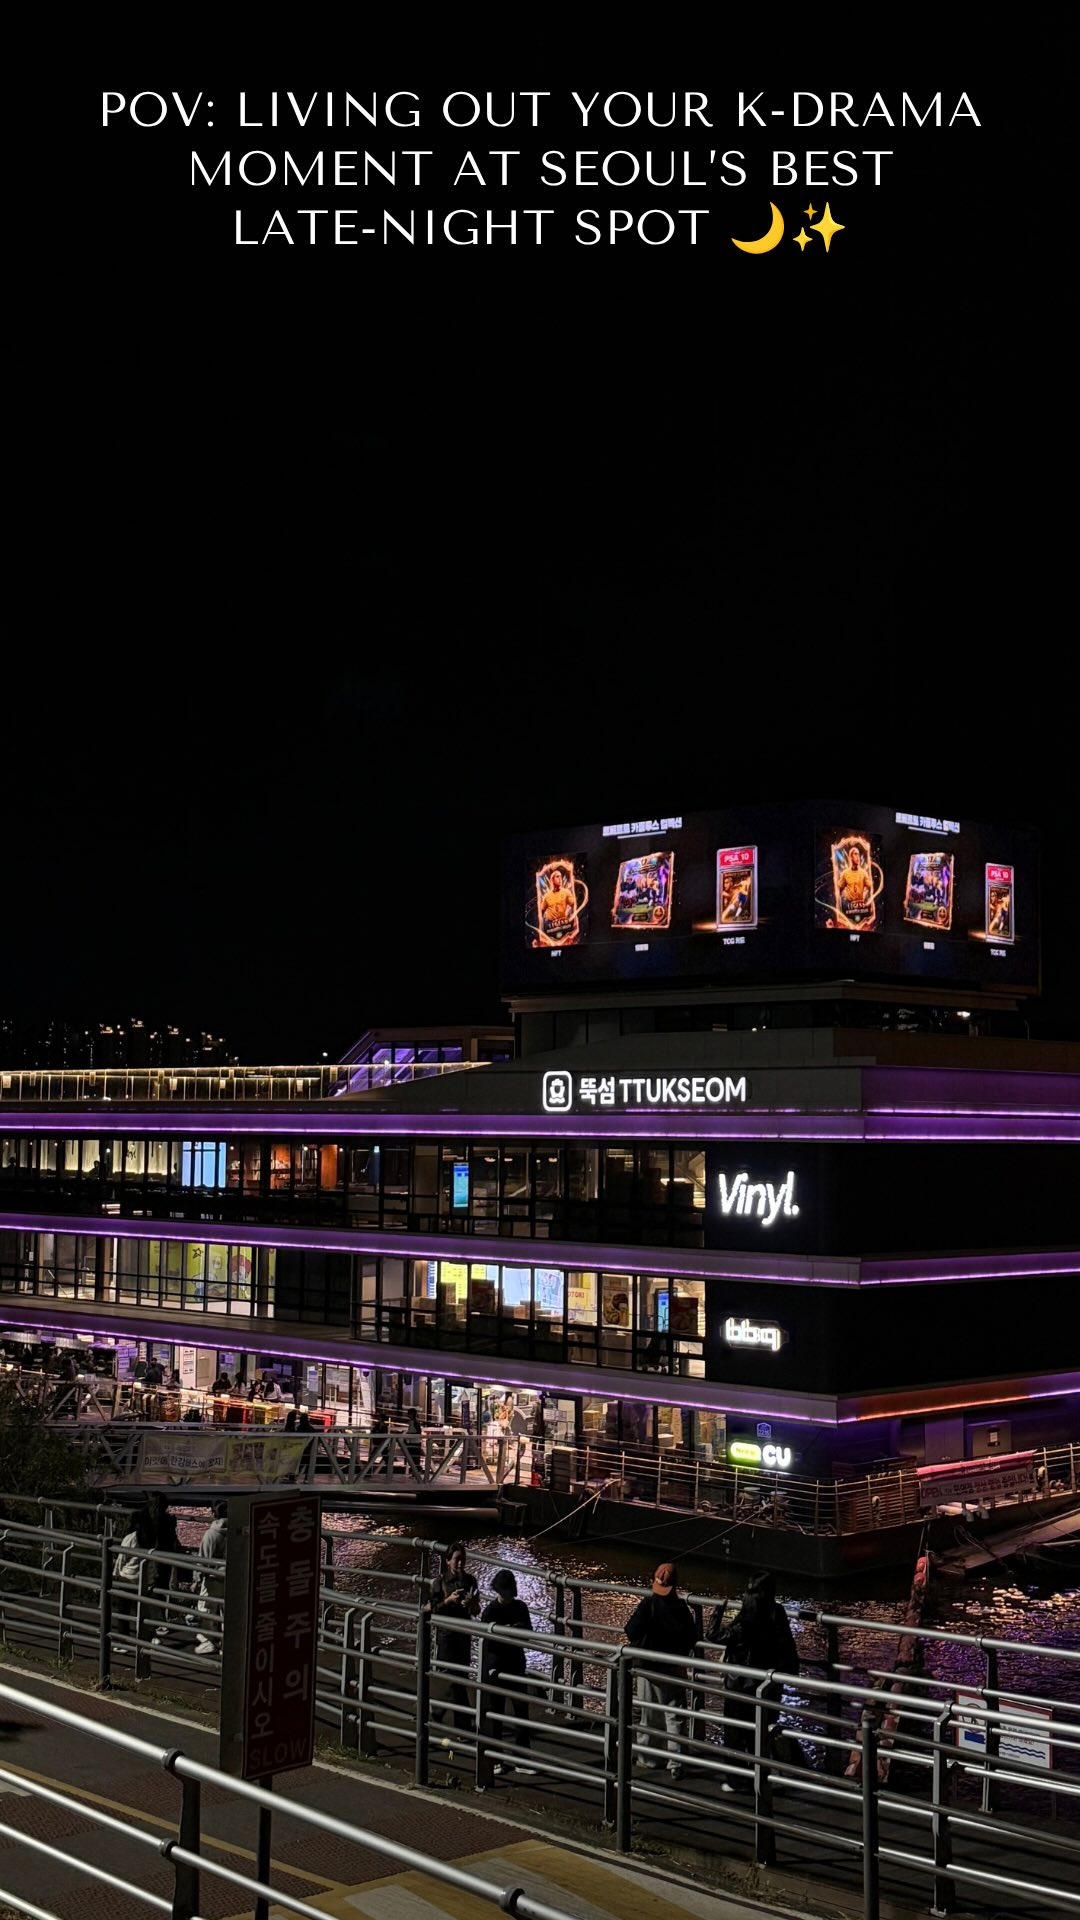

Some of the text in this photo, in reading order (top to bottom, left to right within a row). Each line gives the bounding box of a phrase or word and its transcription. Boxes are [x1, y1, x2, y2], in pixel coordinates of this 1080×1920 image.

[579, 1076, 746, 1105] 뚝섬 TTUKSEOM
[717, 1168, 800, 1227] Vinyl.
[725, 1317, 781, 1352] bbq
[762, 1444, 791, 1466] CU
[250, 1511, 281, 1741] 속도를 줄이시오
[248, 1737, 308, 1770] SLOW
